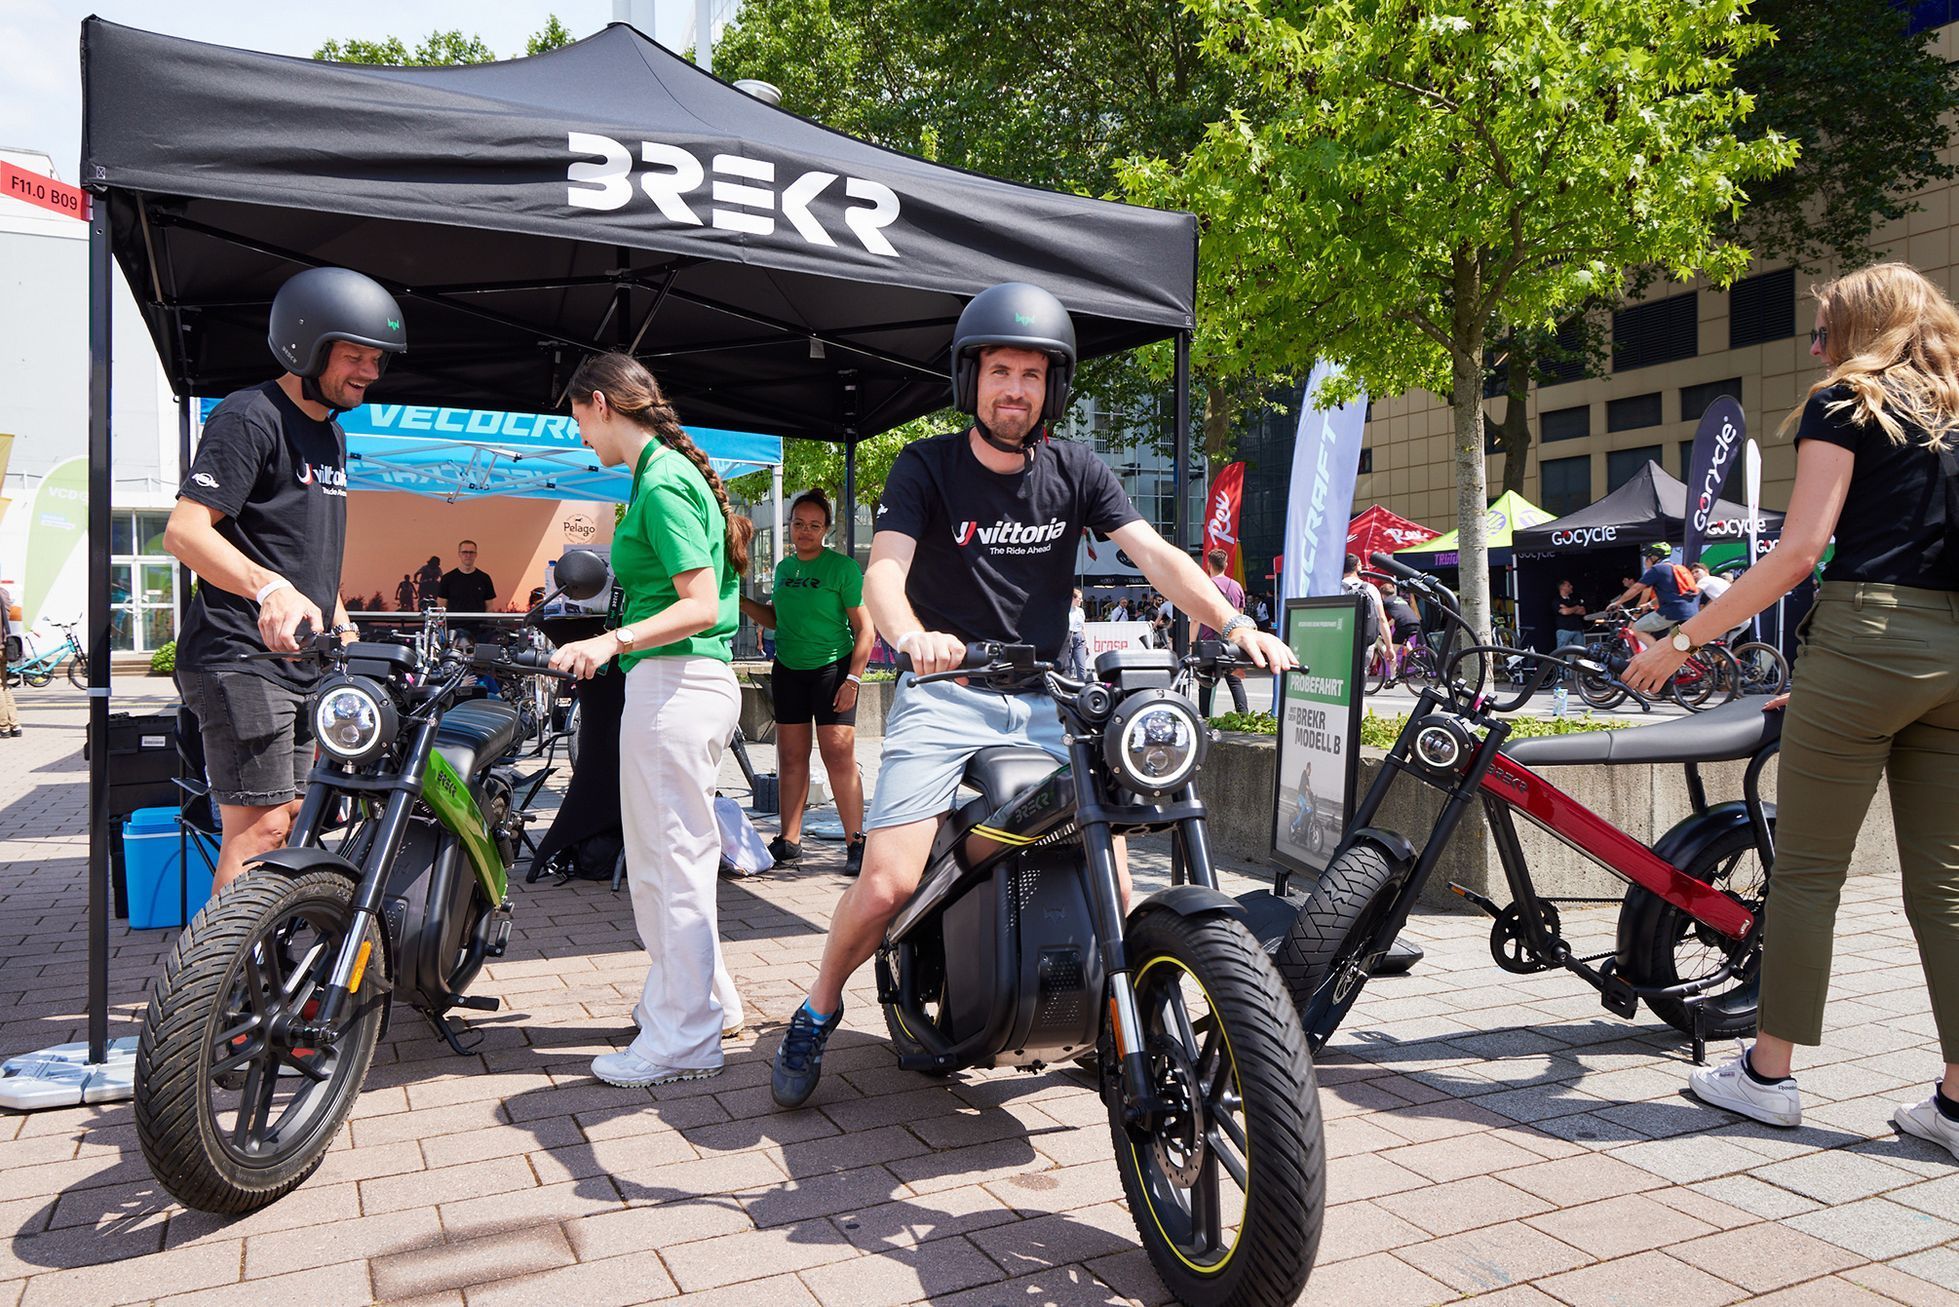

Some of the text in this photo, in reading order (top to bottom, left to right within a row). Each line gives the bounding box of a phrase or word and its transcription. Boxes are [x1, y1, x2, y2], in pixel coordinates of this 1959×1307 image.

[11, 175, 78, 211] F11.0 B09
[567, 131, 901, 258] BREKR
[563, 521, 596, 537] Pelago
[977, 518, 1067, 545] vittoria
[990, 543, 1052, 555] The Ride Ahead
[1290, 674, 1344, 697] PROBEFAHRT
[1296, 707, 1326, 730] BREKR
[1295, 727, 1341, 755] MODELL B
